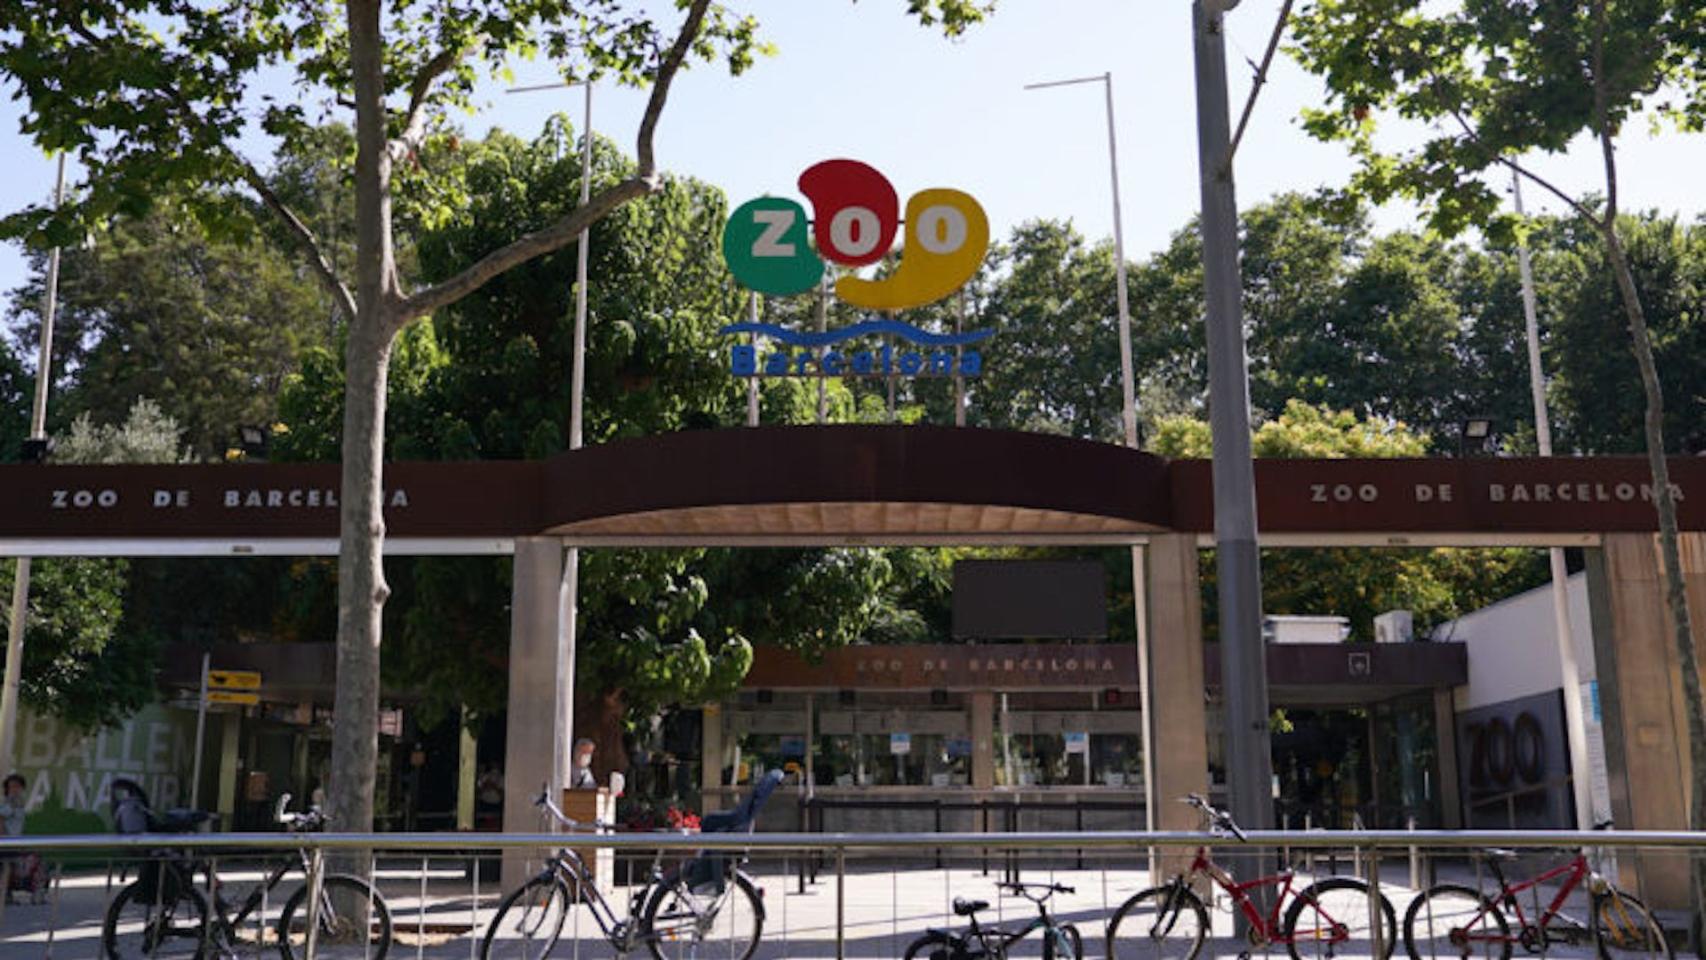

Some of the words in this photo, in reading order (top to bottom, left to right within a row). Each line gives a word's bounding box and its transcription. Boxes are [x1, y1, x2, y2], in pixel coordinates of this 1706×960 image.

[751, 205, 968, 257] ZOO
[731, 344, 982, 376] Barcelona
[51, 490, 118, 507] ZOO
[153, 490, 189, 507] DE
[224, 490, 409, 507] BARCELA
[1310, 483, 1378, 502] ZOO
[1415, 483, 1453, 502] DE
[1489, 482, 1685, 502] BARCELONA
